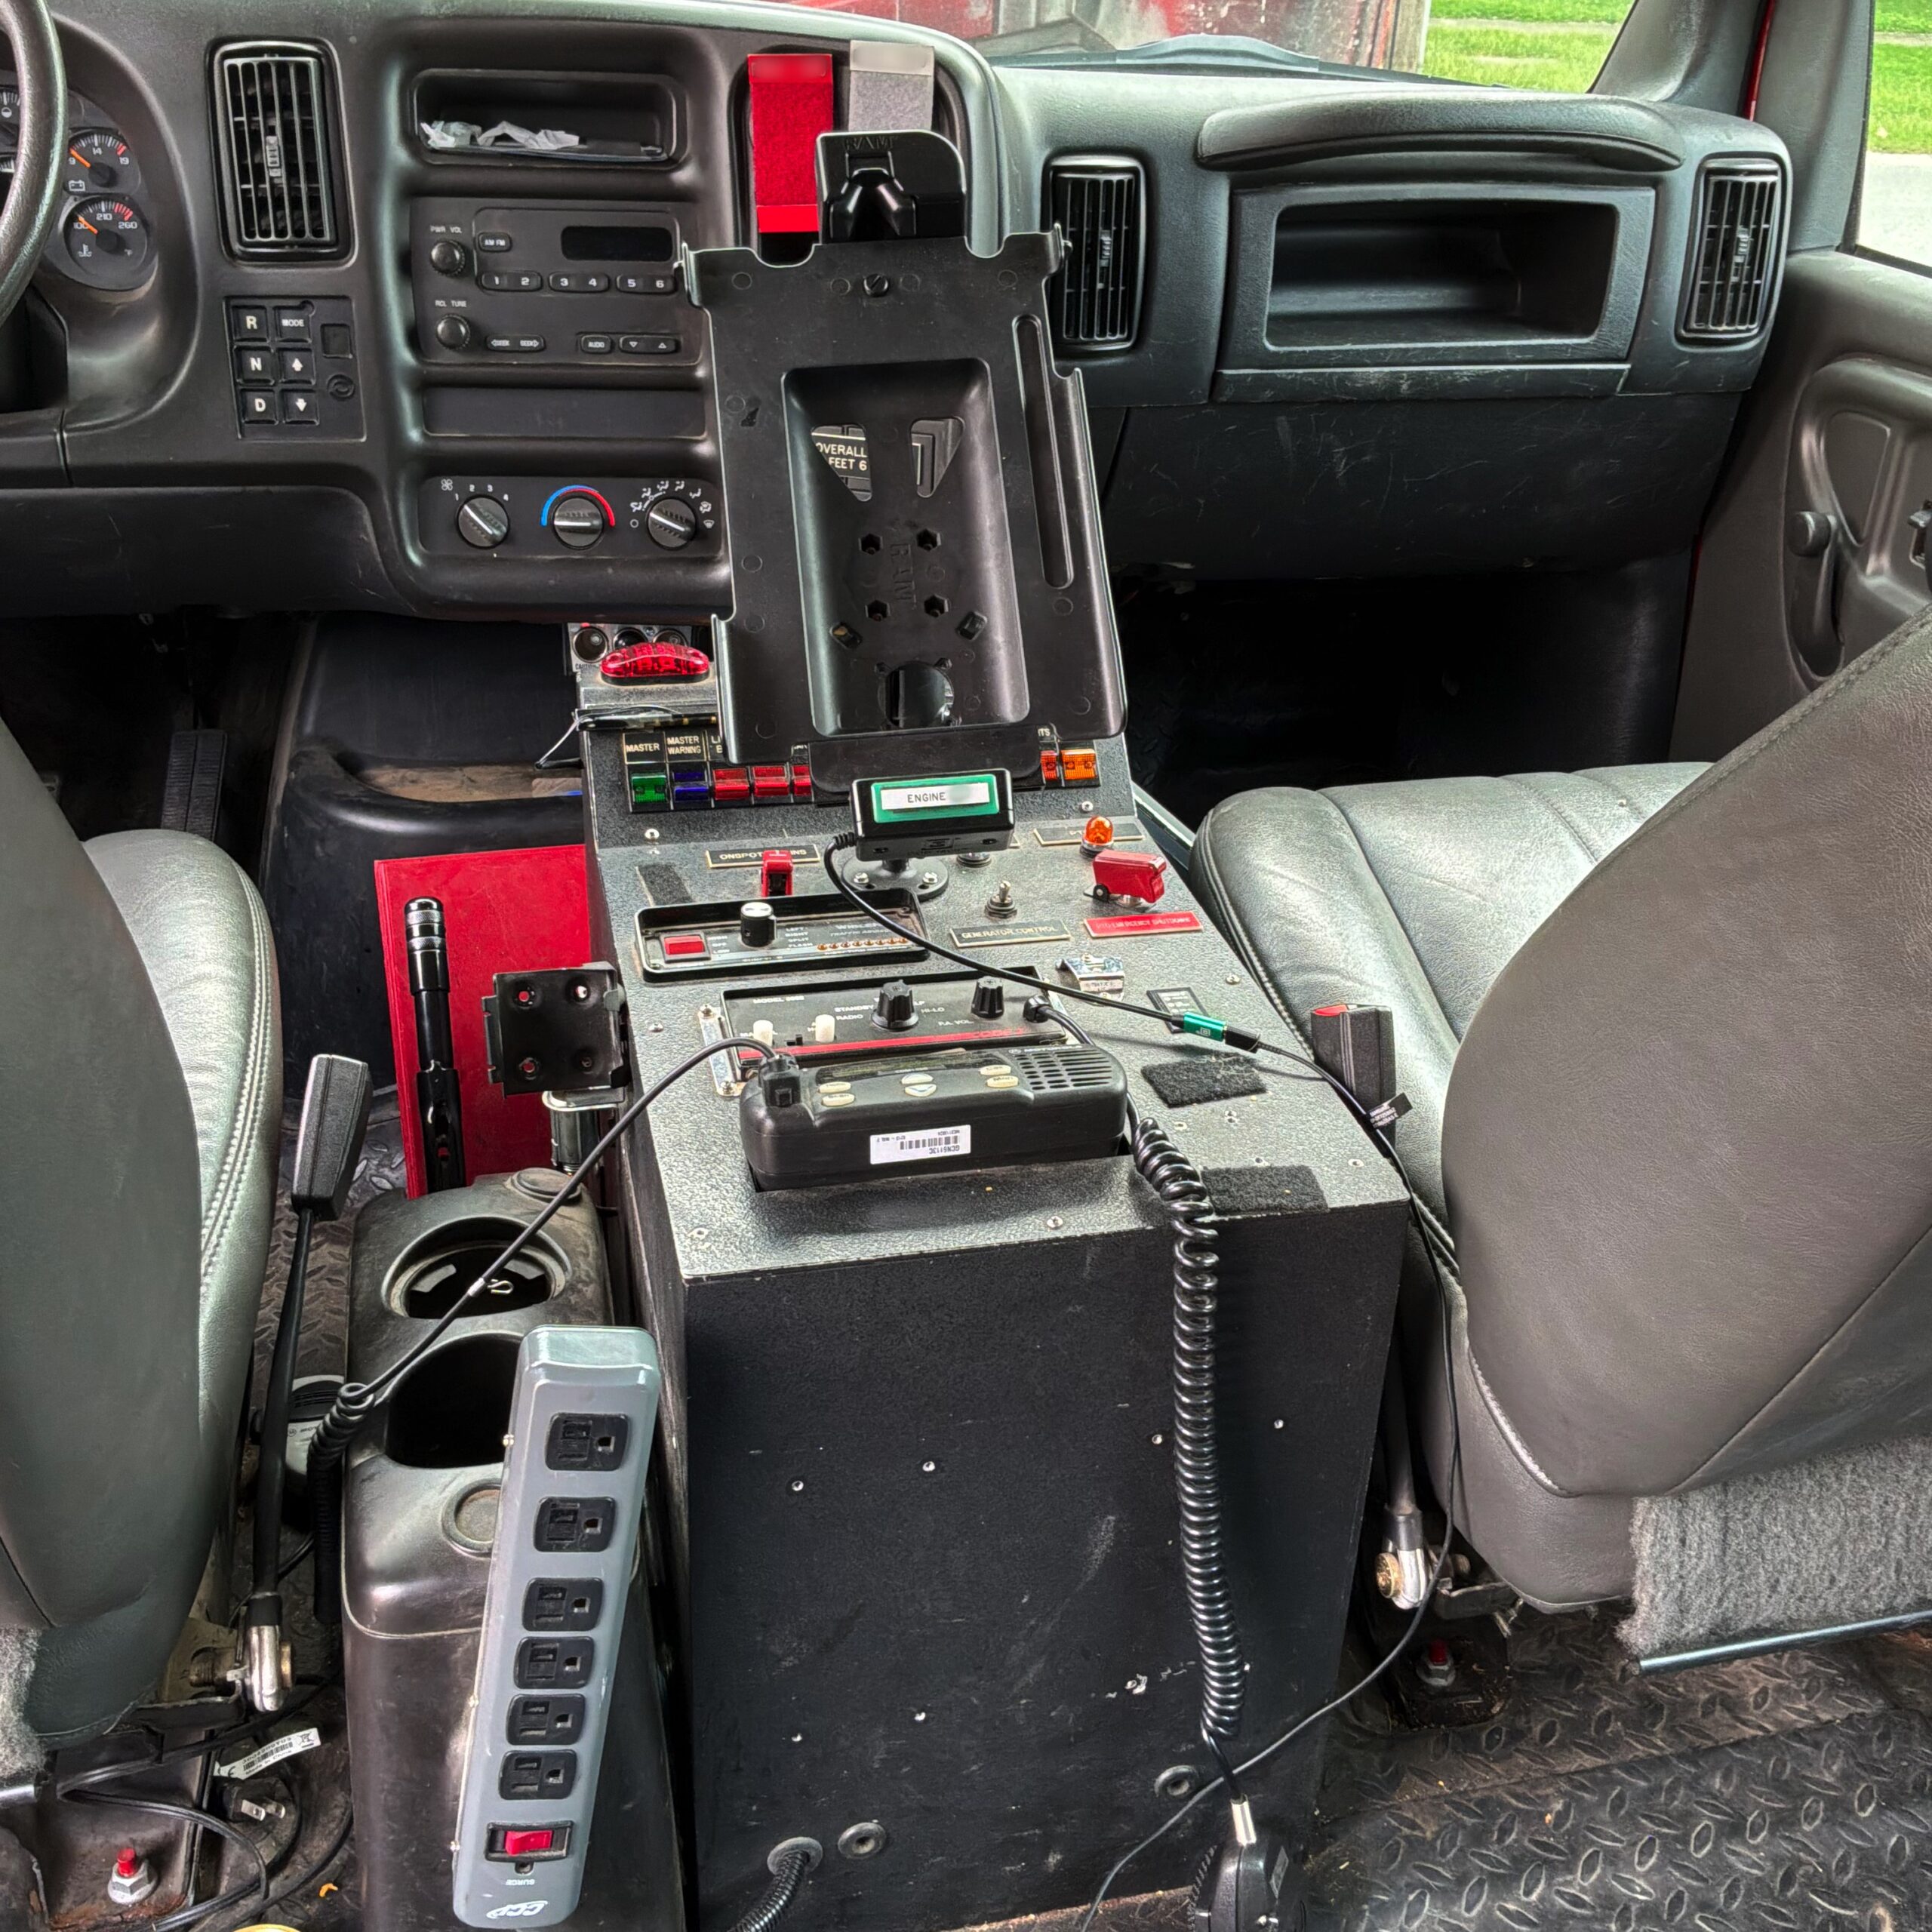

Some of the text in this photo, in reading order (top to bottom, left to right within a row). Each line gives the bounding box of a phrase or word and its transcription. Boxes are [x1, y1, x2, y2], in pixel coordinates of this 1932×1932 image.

[69, 157, 76, 165] 9
[119, 157, 130, 165] 19
[96, 213, 112, 221] 210
[118, 221, 138, 229] 260
[430, 225, 446, 233] PWR
[494, 276, 500, 285] 1
[521, 277, 530, 285] 2
[560, 278, 568, 287] 3
[589, 278, 597, 287] 4
[628, 279, 636, 288] 5
[656, 280, 664, 288] 6
[451, 300, 467, 308] TUNE
[246, 315, 258, 329] R
[281, 318, 305, 327] MODE
[250, 357, 262, 371] N
[254, 398, 266, 412] D
[828, 457, 867, 471] FEET 6
[667, 736, 700, 745] MASTER
[626, 743, 660, 753] MASTER
[668, 746, 702, 755] WARNING
[906, 792, 946, 804] ENGINE
[719, 852, 762, 860] ONSPOT
[961, 925, 1058, 939] GENERATOR CONTROL
[834, 1004, 875, 1013] STANDBY
[929, 1145, 960, 1155] GCN6113C
